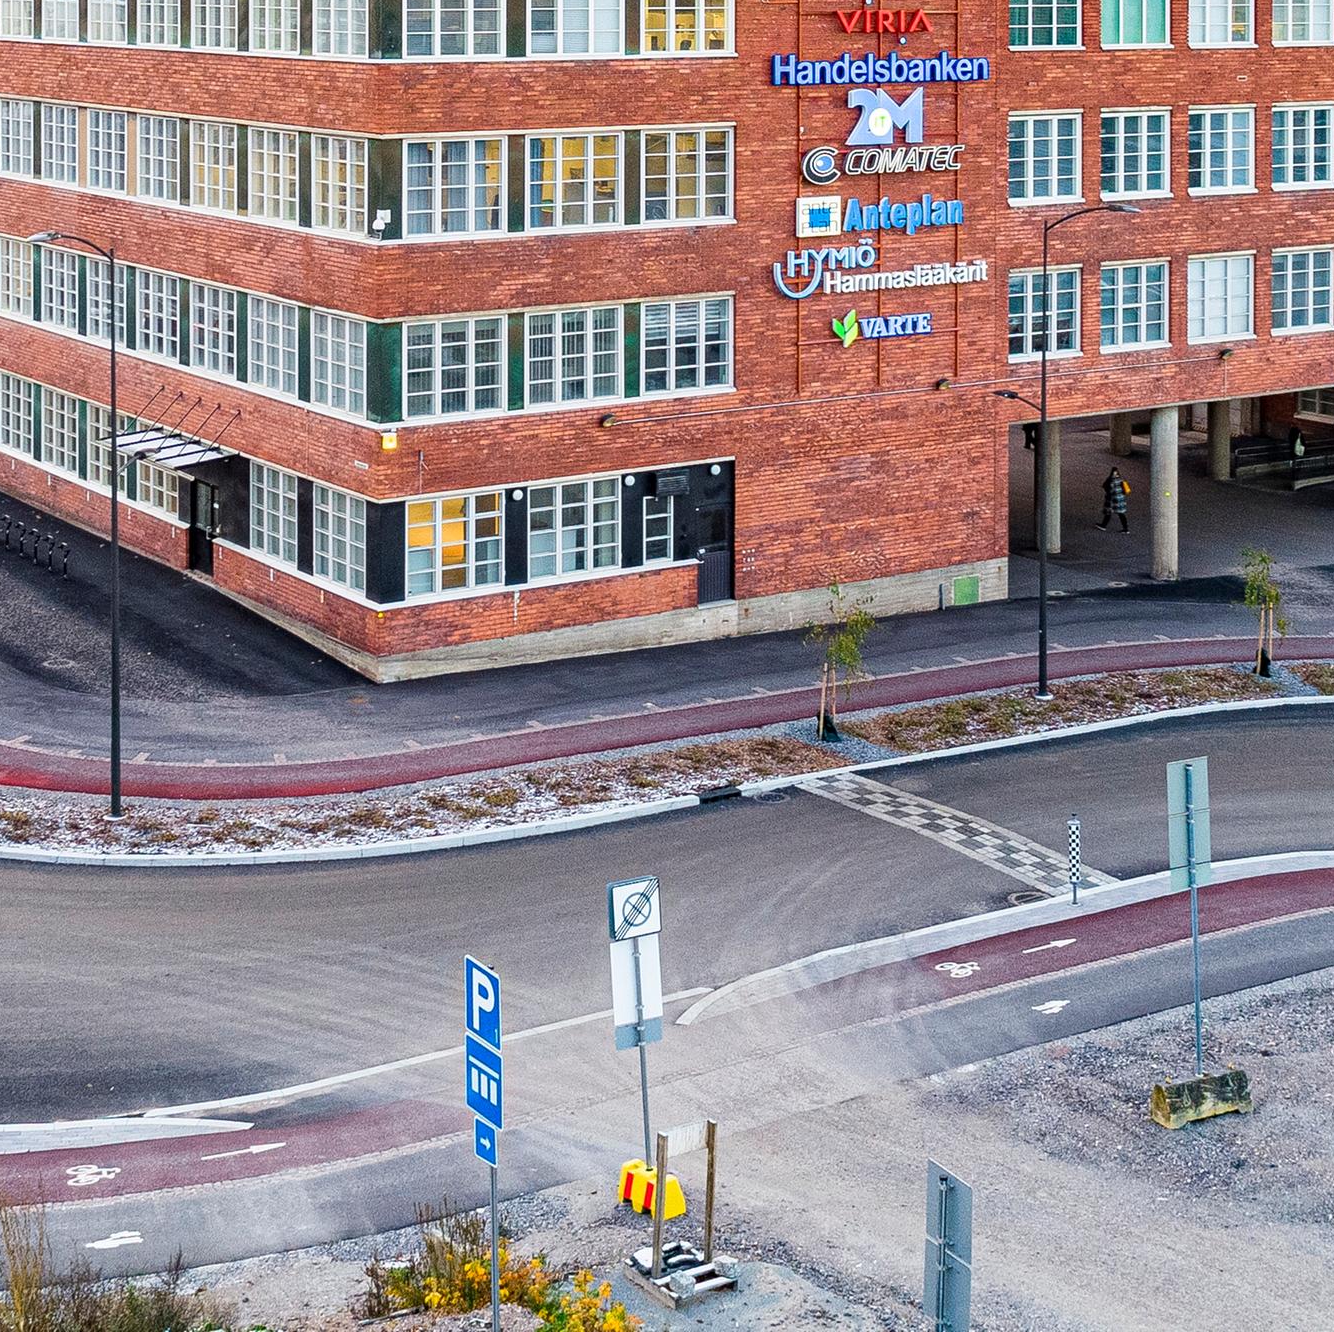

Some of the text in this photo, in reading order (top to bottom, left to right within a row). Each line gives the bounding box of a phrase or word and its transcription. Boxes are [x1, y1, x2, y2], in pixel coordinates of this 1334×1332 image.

[837, 8, 934, 34] VIRIA
[771, 51, 990, 86] Handelsbanken
[844, 86, 924, 146] 2M
[844, 145, 966, 175] COMATEC
[802, 201, 839, 215] ante
[843, 194, 964, 236] Anteplan
[785, 238, 877, 281] HYMIÖ
[823, 259, 988, 295] Hammaslääkärit
[859, 312, 933, 339] VARTE
[472, 967, 495, 1031] P
